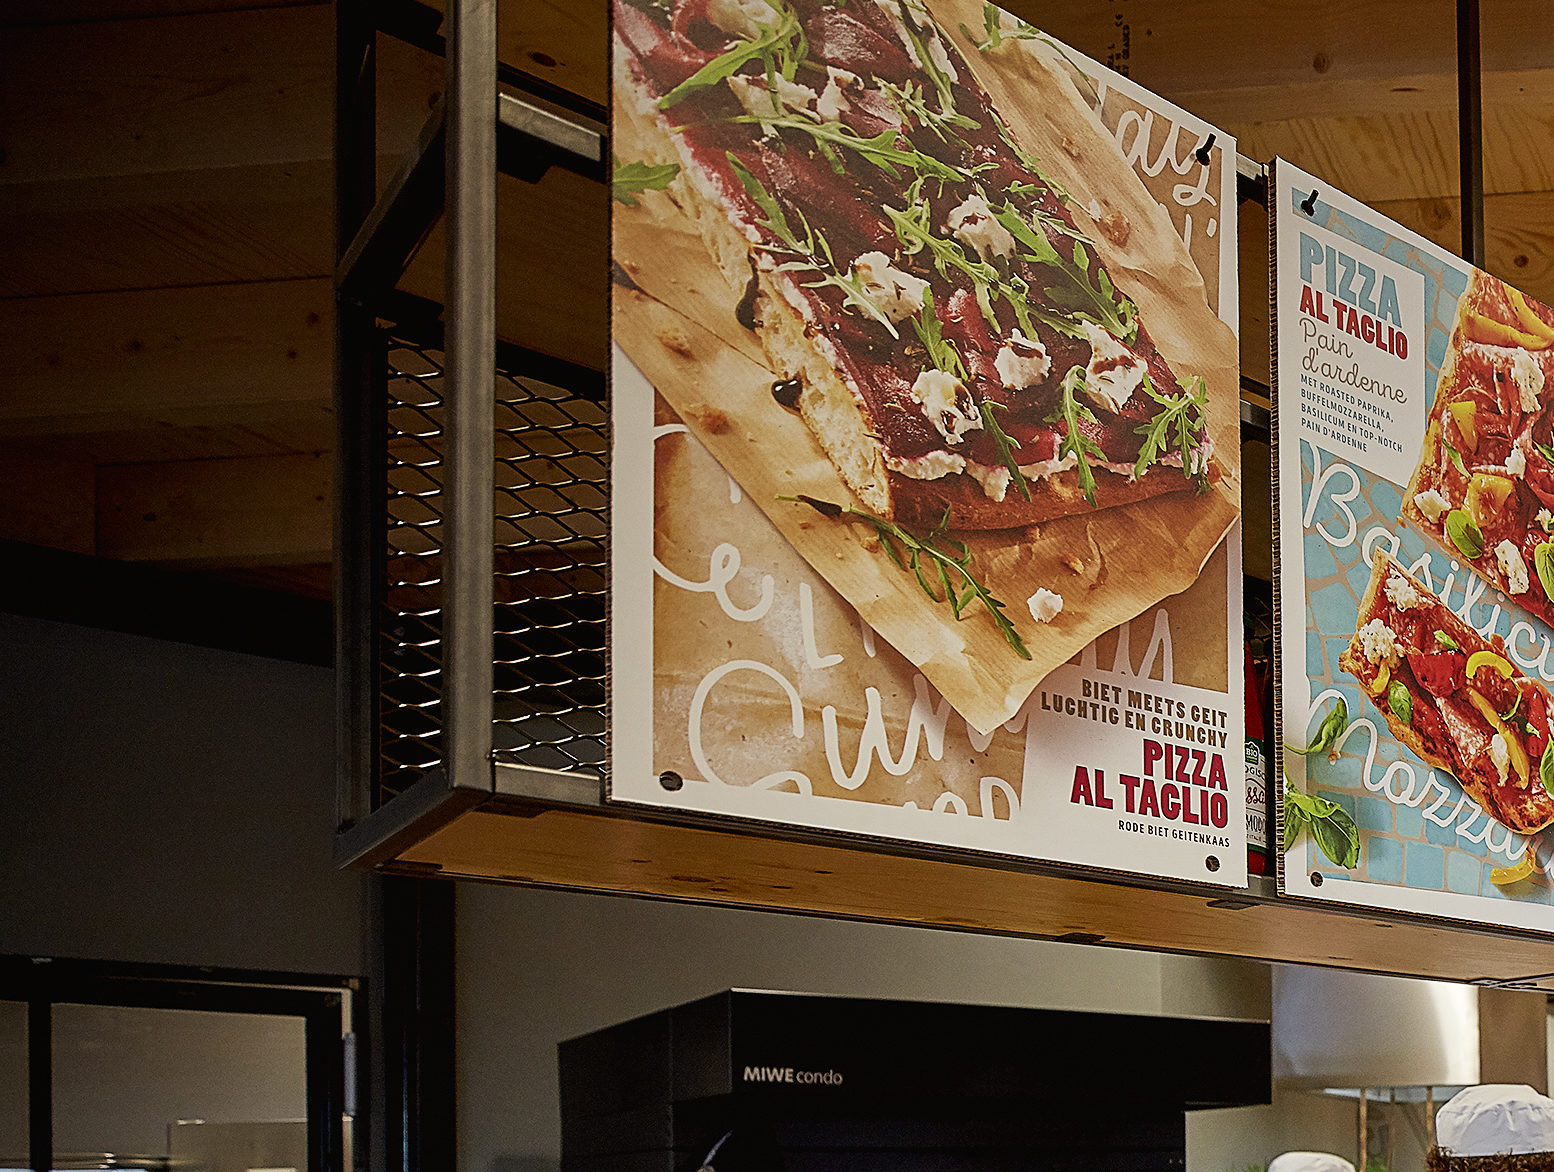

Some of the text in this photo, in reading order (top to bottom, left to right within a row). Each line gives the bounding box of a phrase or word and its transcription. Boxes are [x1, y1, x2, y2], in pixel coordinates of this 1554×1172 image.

[1300, 231, 1402, 328] PIZZA
[1300, 285, 1408, 360] AL TAGLIO
[1300, 318, 1353, 358] Pain
[1301, 374, 1393, 423] MET ROASTED PAPRIKA,
[1302, 347, 1407, 404] d'ardenne
[1301, 388, 1384, 432] BUFFELMOZZARELLA,
[1301, 403, 1402, 453] BASILICUM EN TOP-NOTCH
[1301, 418, 1367, 452] PAIN D'ARDENNE
[1041, 692, 1228, 749] LUCHTIG EN CRUNCHY
[1082, 679, 1227, 728] BIET MEETS GEIT
[1143, 738, 1228, 791] PIZZA
[1070, 765, 1229, 829] AL TAGLIO
[1118, 820, 1144, 834] RODE
[1148, 824, 1168, 838] BIET
[1172, 828, 1230, 847] GEITENKAAS
[743, 1066, 844, 1085] MIWE condo
